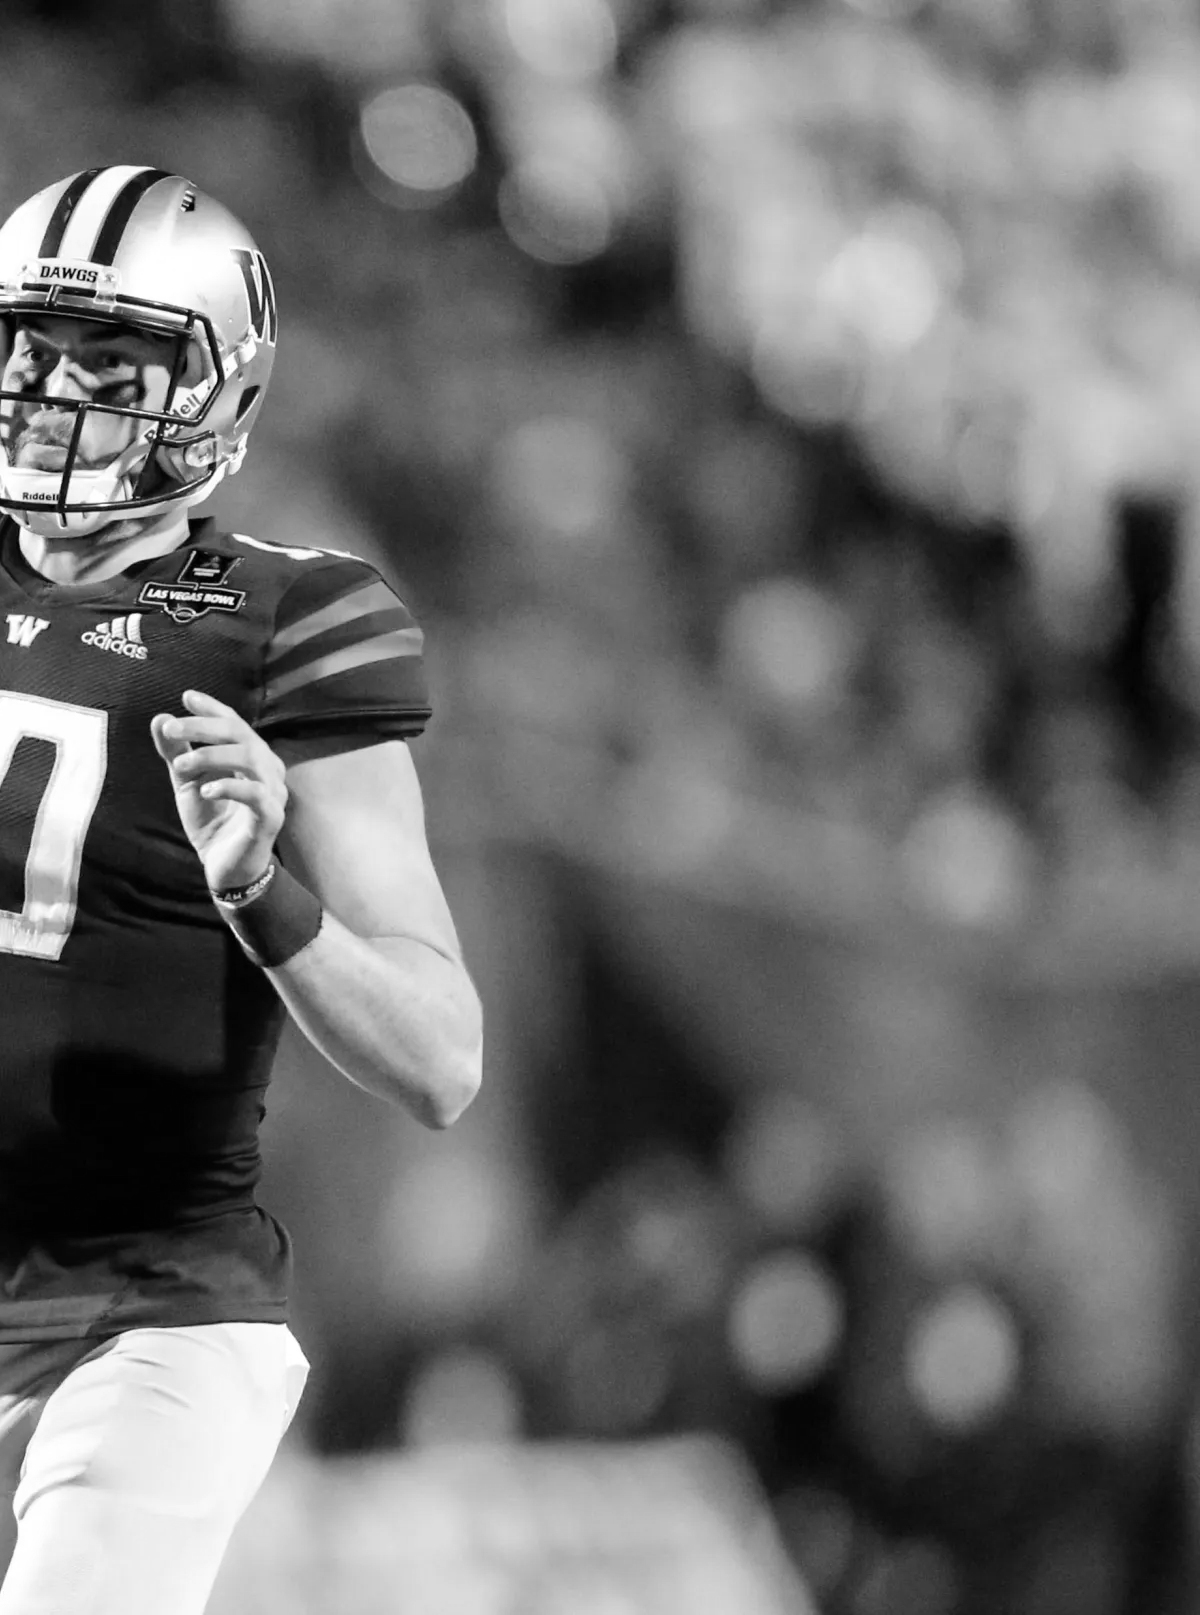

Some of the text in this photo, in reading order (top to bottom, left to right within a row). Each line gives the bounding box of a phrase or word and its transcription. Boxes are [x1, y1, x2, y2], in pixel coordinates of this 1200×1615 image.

[40, 265, 98, 283] DAWGS
[22, 492, 60, 501] Riddell
[146, 588, 236, 606] LAS VEGAS BOWL
[5, 614, 51, 647] W
[81, 631, 148, 660] adidas
